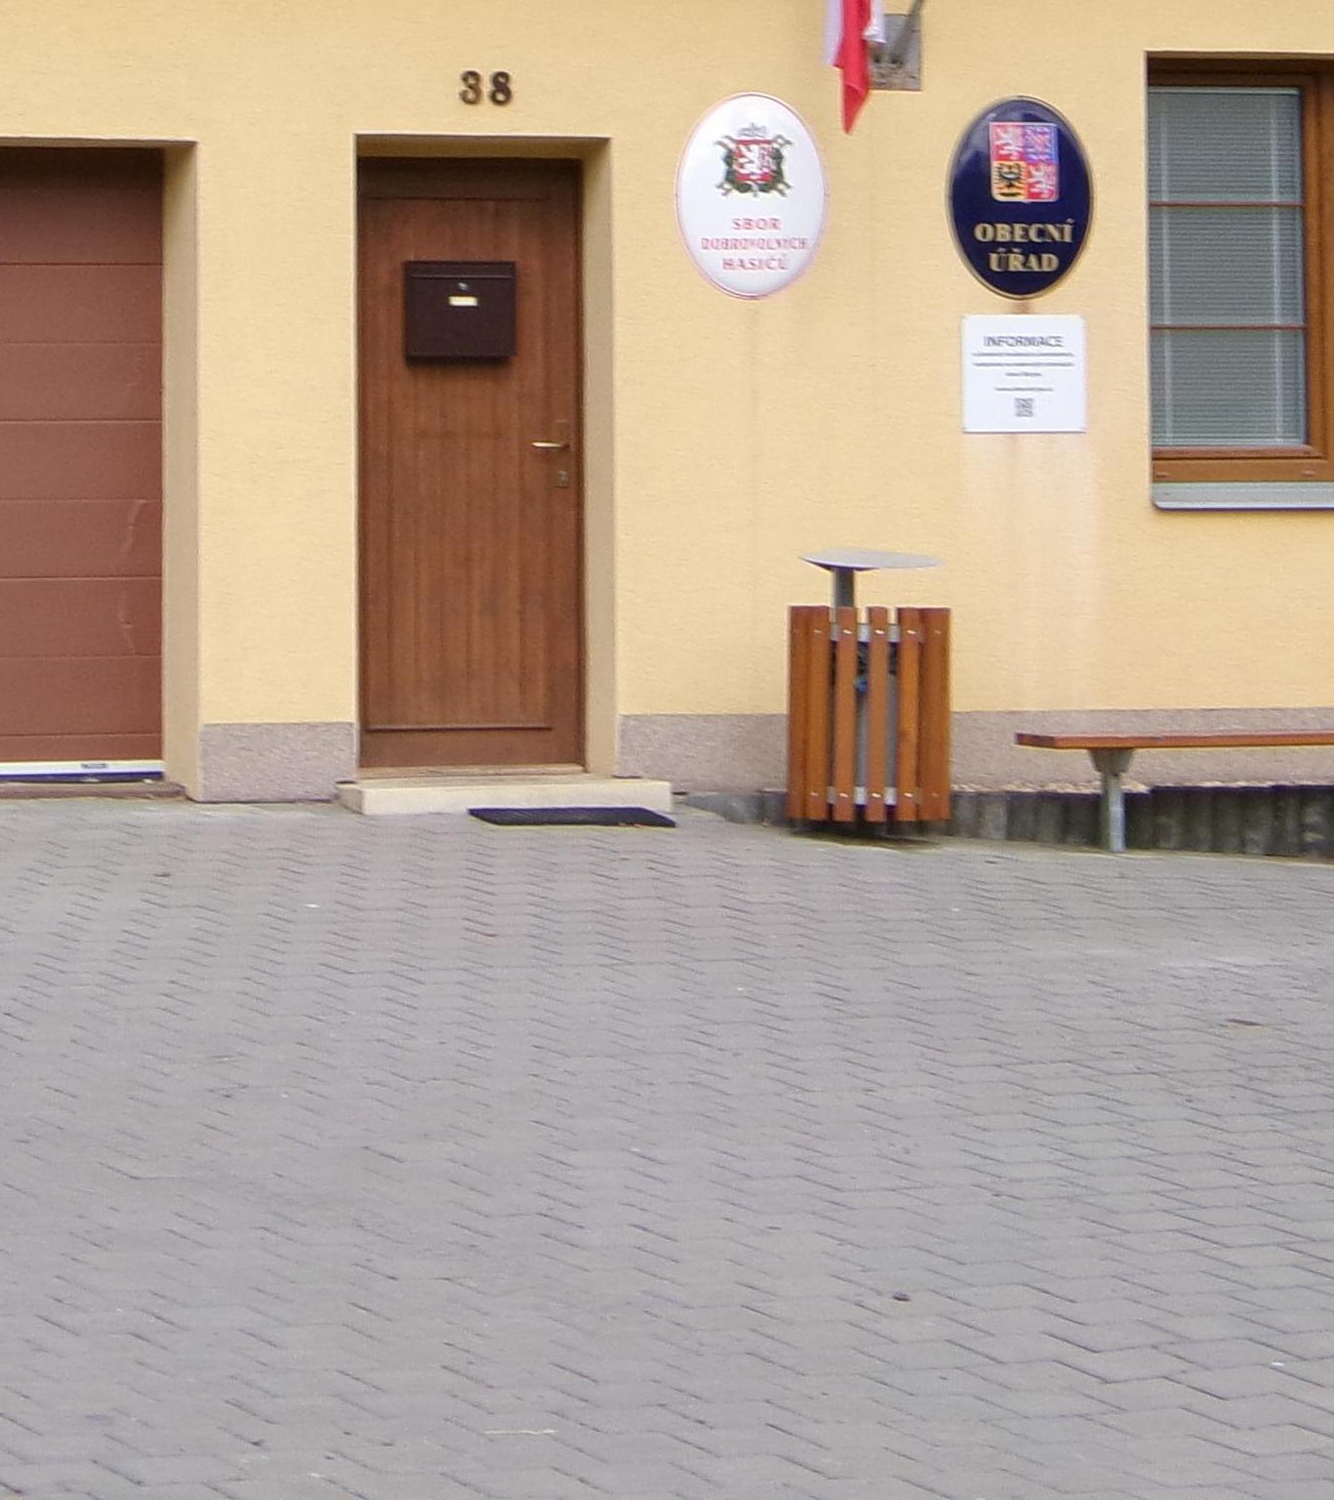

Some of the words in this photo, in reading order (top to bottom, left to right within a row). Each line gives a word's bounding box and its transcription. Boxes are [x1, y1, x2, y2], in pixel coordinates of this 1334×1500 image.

[459, 70, 512, 106] 38
[731, 217, 782, 231] SBOR
[973, 218, 1076, 243] OBECNÍ
[988, 247, 1060, 272] ÚŘAD
